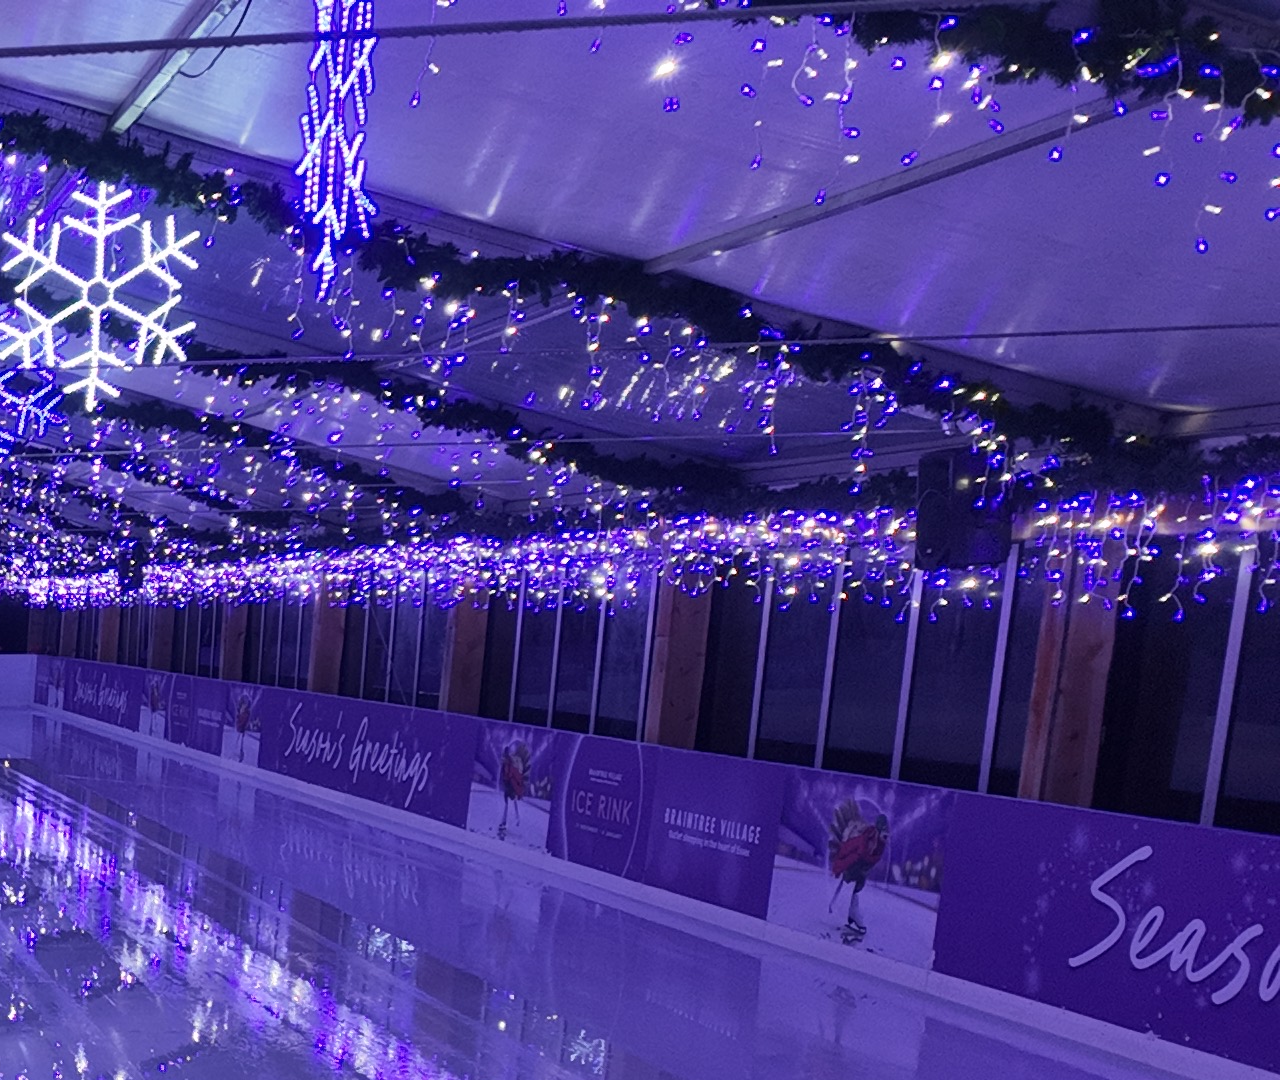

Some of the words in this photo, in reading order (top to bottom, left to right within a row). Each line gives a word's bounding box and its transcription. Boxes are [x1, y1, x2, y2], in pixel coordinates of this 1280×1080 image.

[284, 702, 346, 769] Season's
[349, 716, 432, 808] Greetings
[571, 789, 594, 816] ICE
[597, 794, 633, 826] RINK
[664, 807, 717, 834] BRAINTREE
[720, 818, 761, 845] VILLAGE
